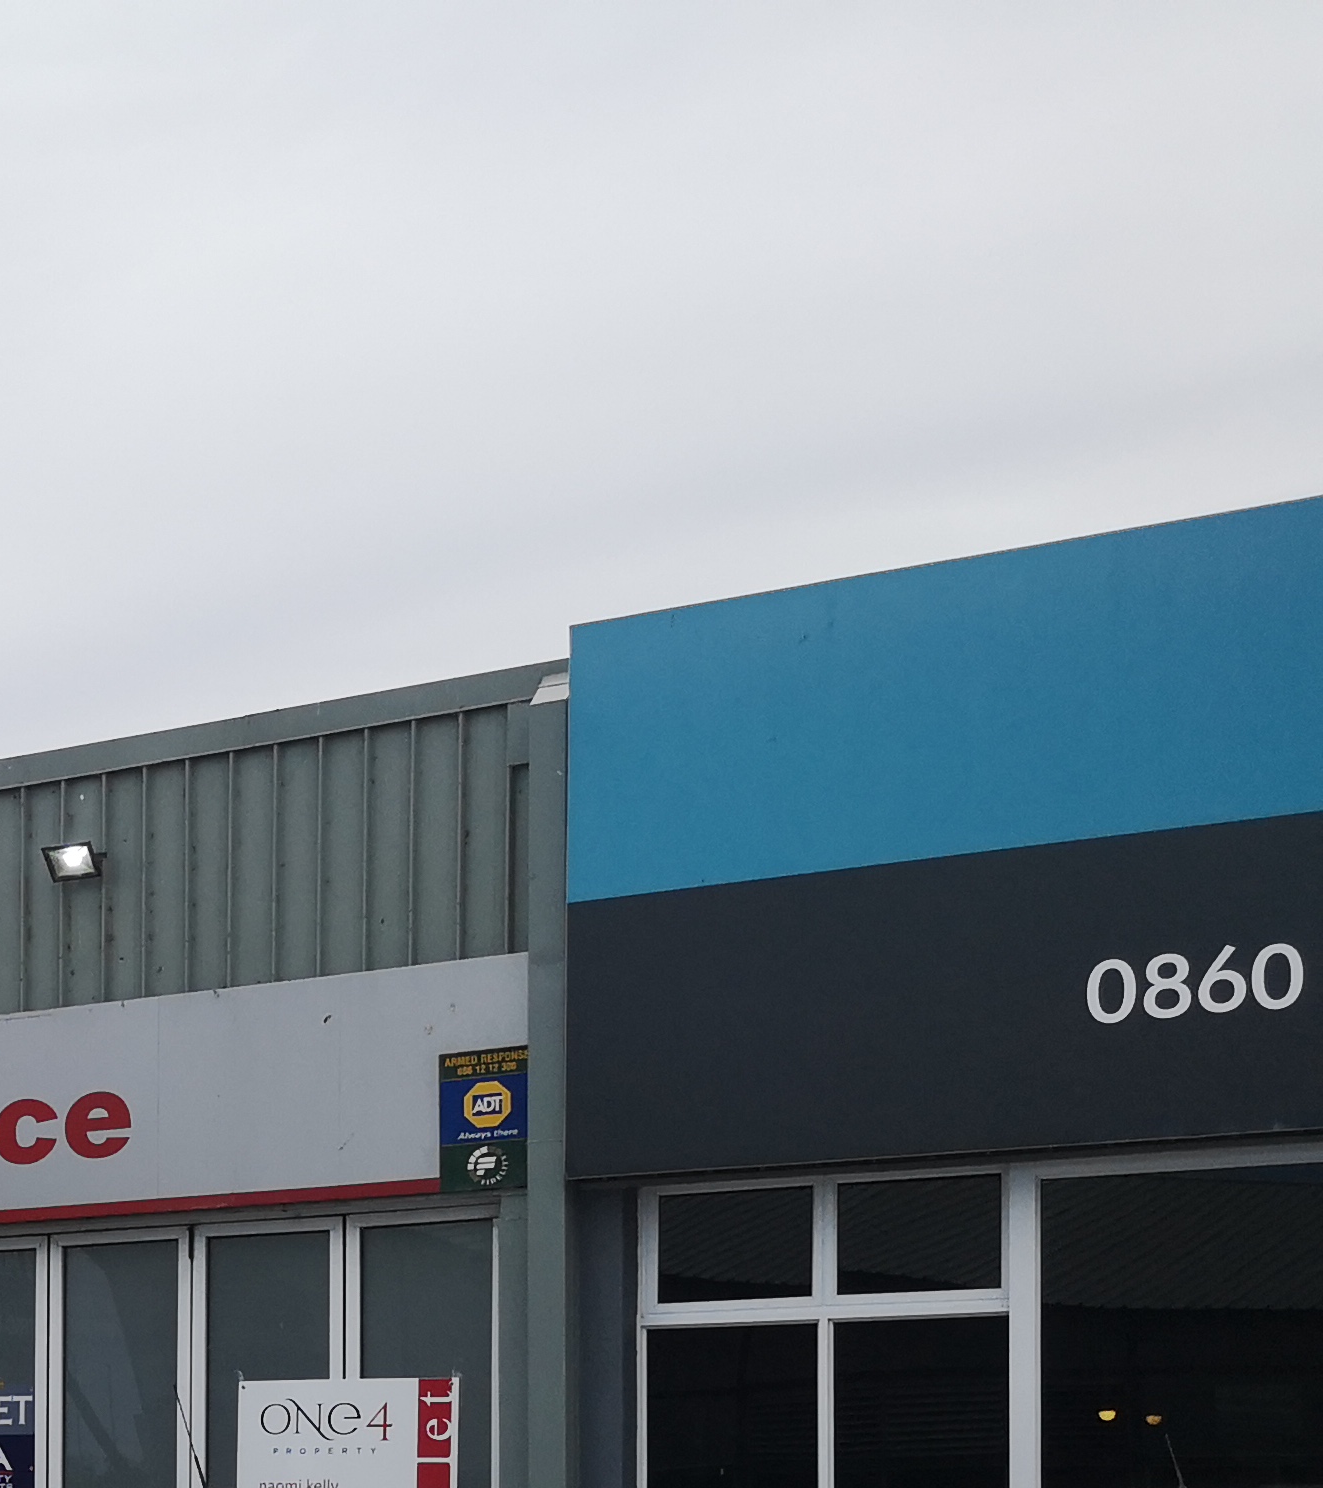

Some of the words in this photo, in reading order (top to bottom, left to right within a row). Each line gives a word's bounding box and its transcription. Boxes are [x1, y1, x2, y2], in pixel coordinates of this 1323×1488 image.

[1086, 943, 1305, 1024] 0860
[444, 1055, 478, 1068] ARMED
[472, 1095, 504, 1115] ADT
[457, 1130, 492, 1141] Always
[493, 1128, 519, 1138] there
[272, 1447, 378, 1455] PROPERTY
